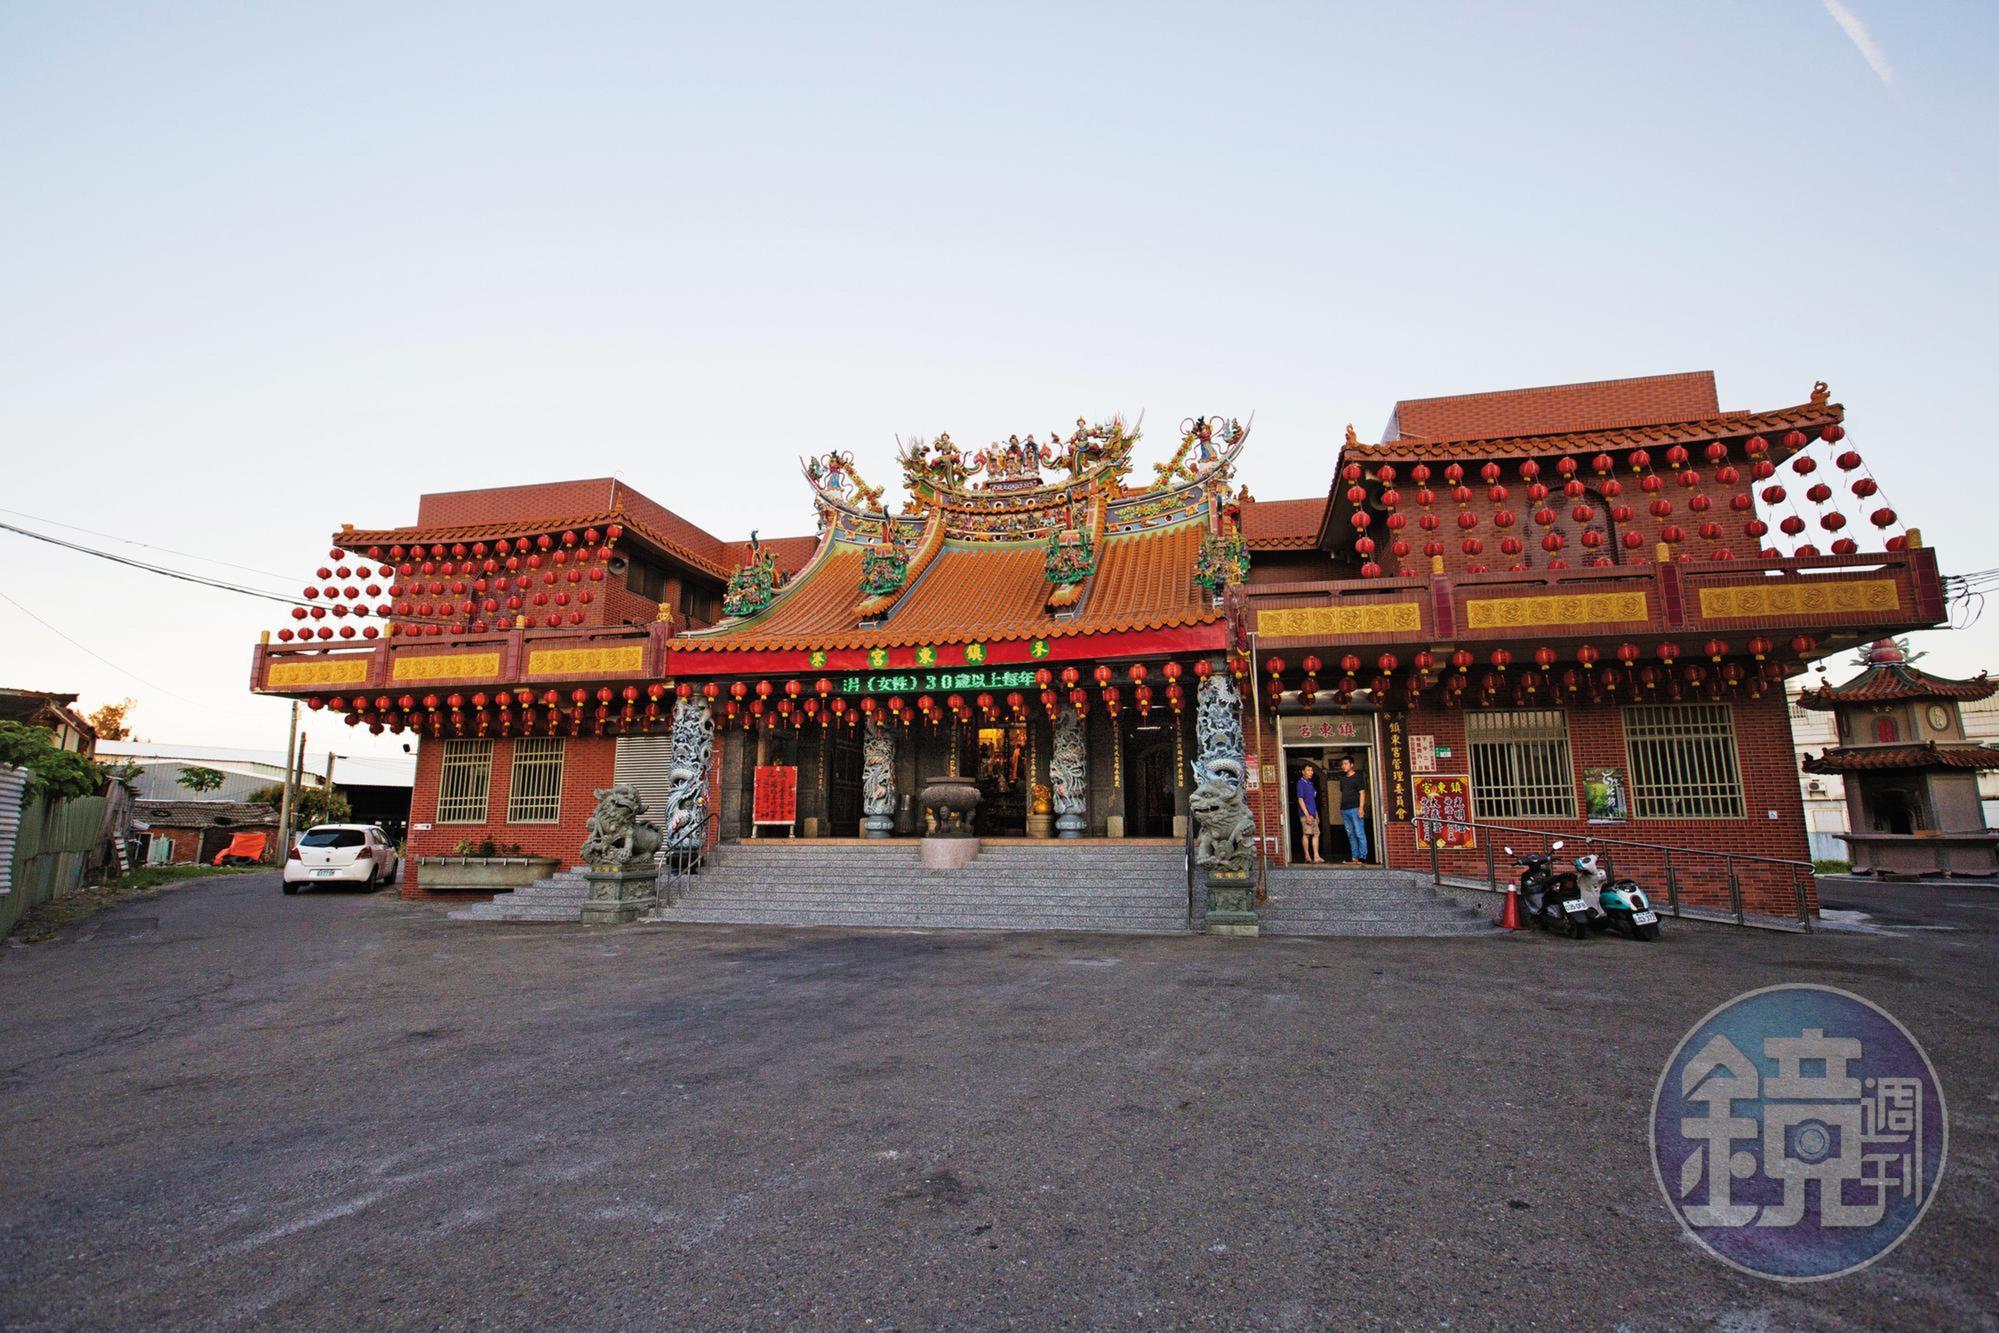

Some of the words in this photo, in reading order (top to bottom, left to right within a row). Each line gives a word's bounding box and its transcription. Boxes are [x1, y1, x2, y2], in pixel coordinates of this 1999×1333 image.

[1299, 721, 1357, 738] 鎮東宮
[1422, 781, 1462, 794] 鎮東宮
